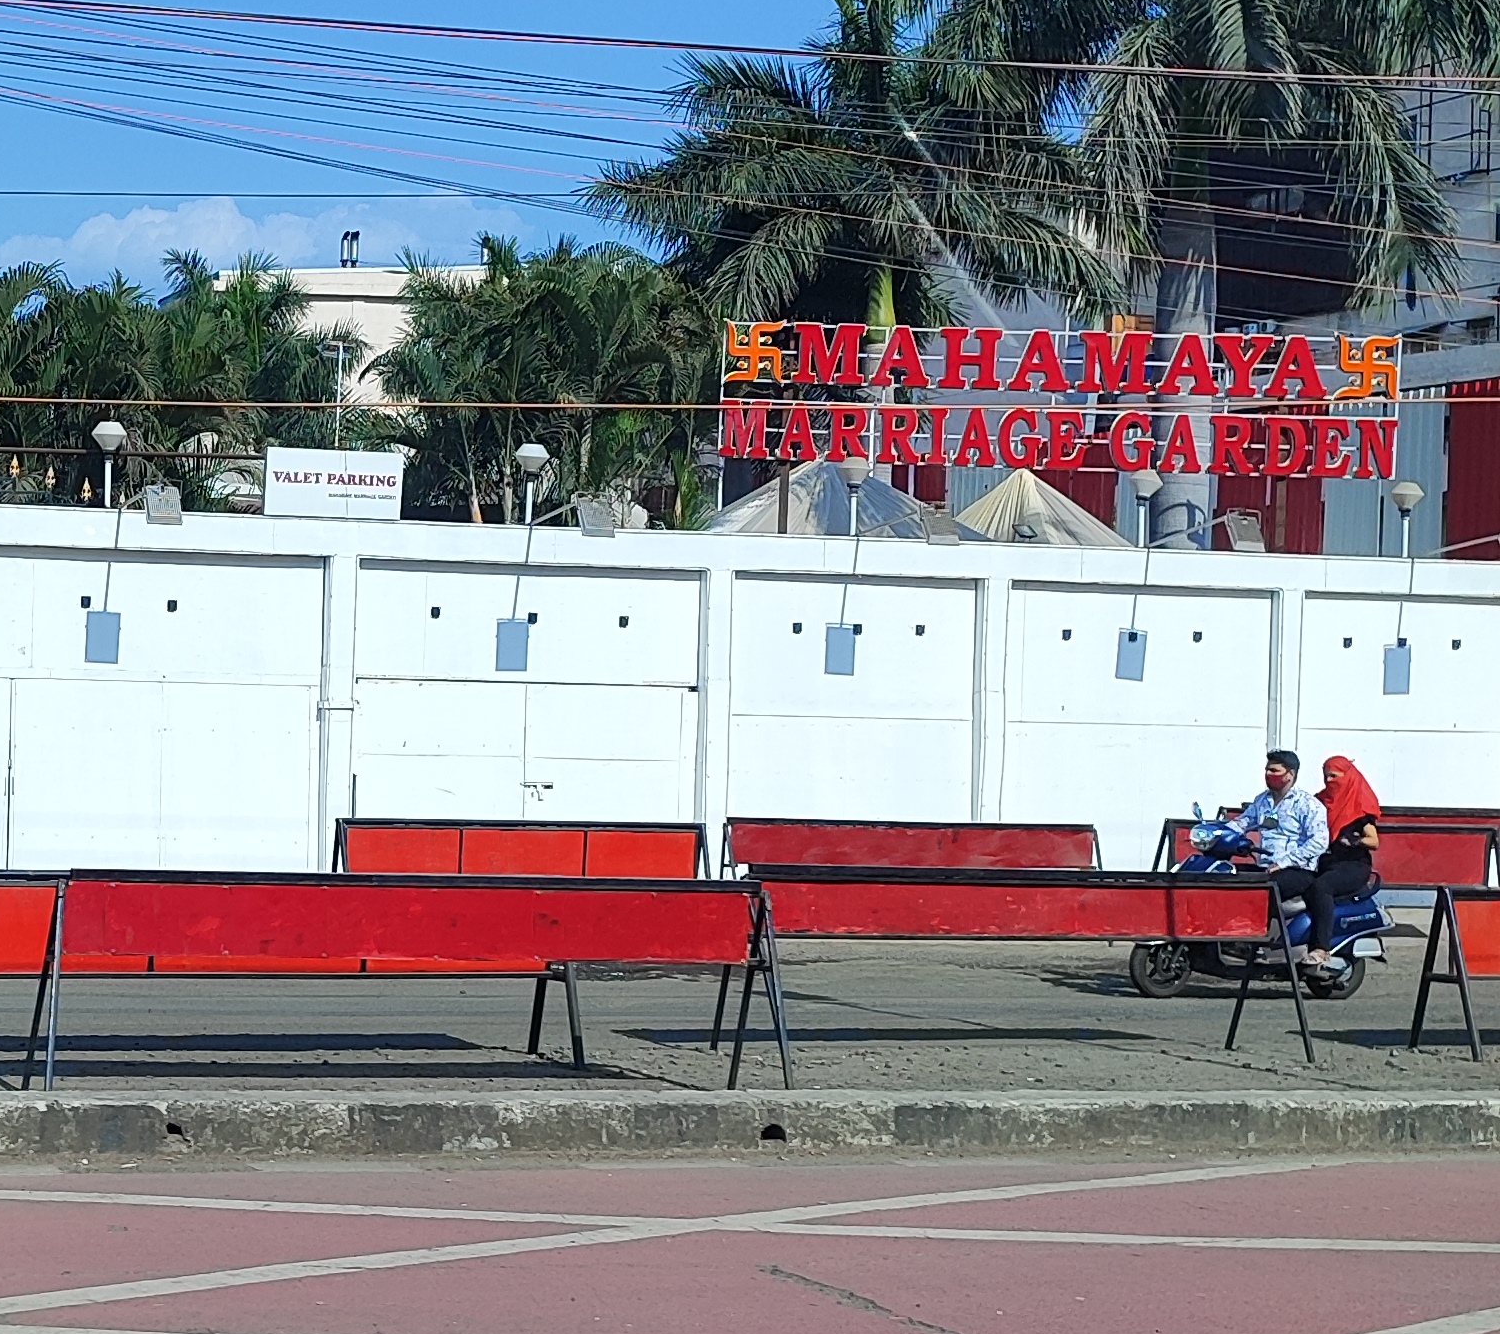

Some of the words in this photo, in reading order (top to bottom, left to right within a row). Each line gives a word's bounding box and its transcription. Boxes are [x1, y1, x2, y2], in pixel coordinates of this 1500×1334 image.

[791, 323, 1328, 399] MAHAMAYA
[719, 400, 1088, 470] MARRIAGE
[1108, 410, 1399, 480] GARDEN
[272, 470, 323, 485] VALET
[326, 472, 398, 488] PARKING
